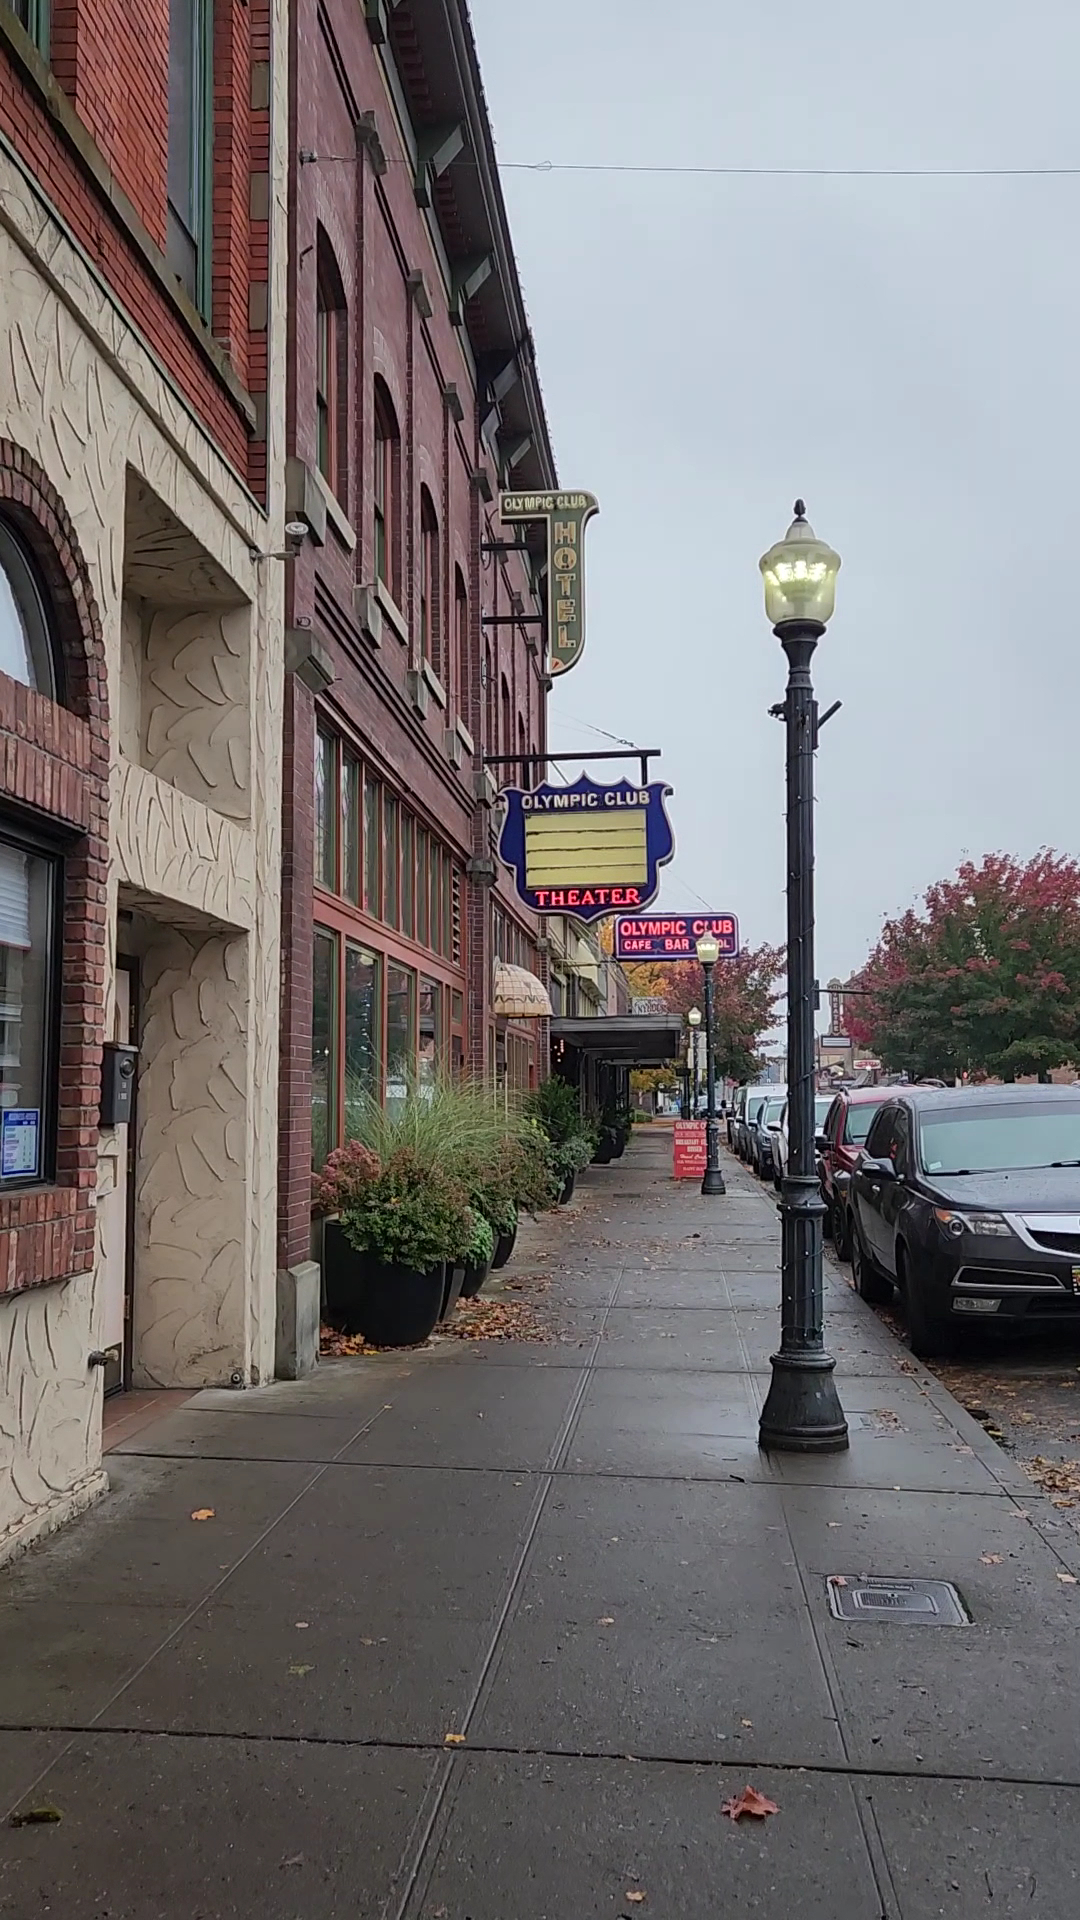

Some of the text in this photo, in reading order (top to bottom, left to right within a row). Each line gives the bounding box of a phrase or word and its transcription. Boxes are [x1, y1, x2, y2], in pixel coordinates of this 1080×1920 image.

[504, 494, 587, 512] OLYMPIC CLUB
[554, 521, 577, 648] HOTEL
[521, 790, 651, 810] OLYMPIC CLUB
[535, 888, 641, 907] THEATER
[620, 919, 733, 936] OLYMPIC CLUB
[624, 940, 652, 950] CAFE
[664, 938, 690, 950] BAR
